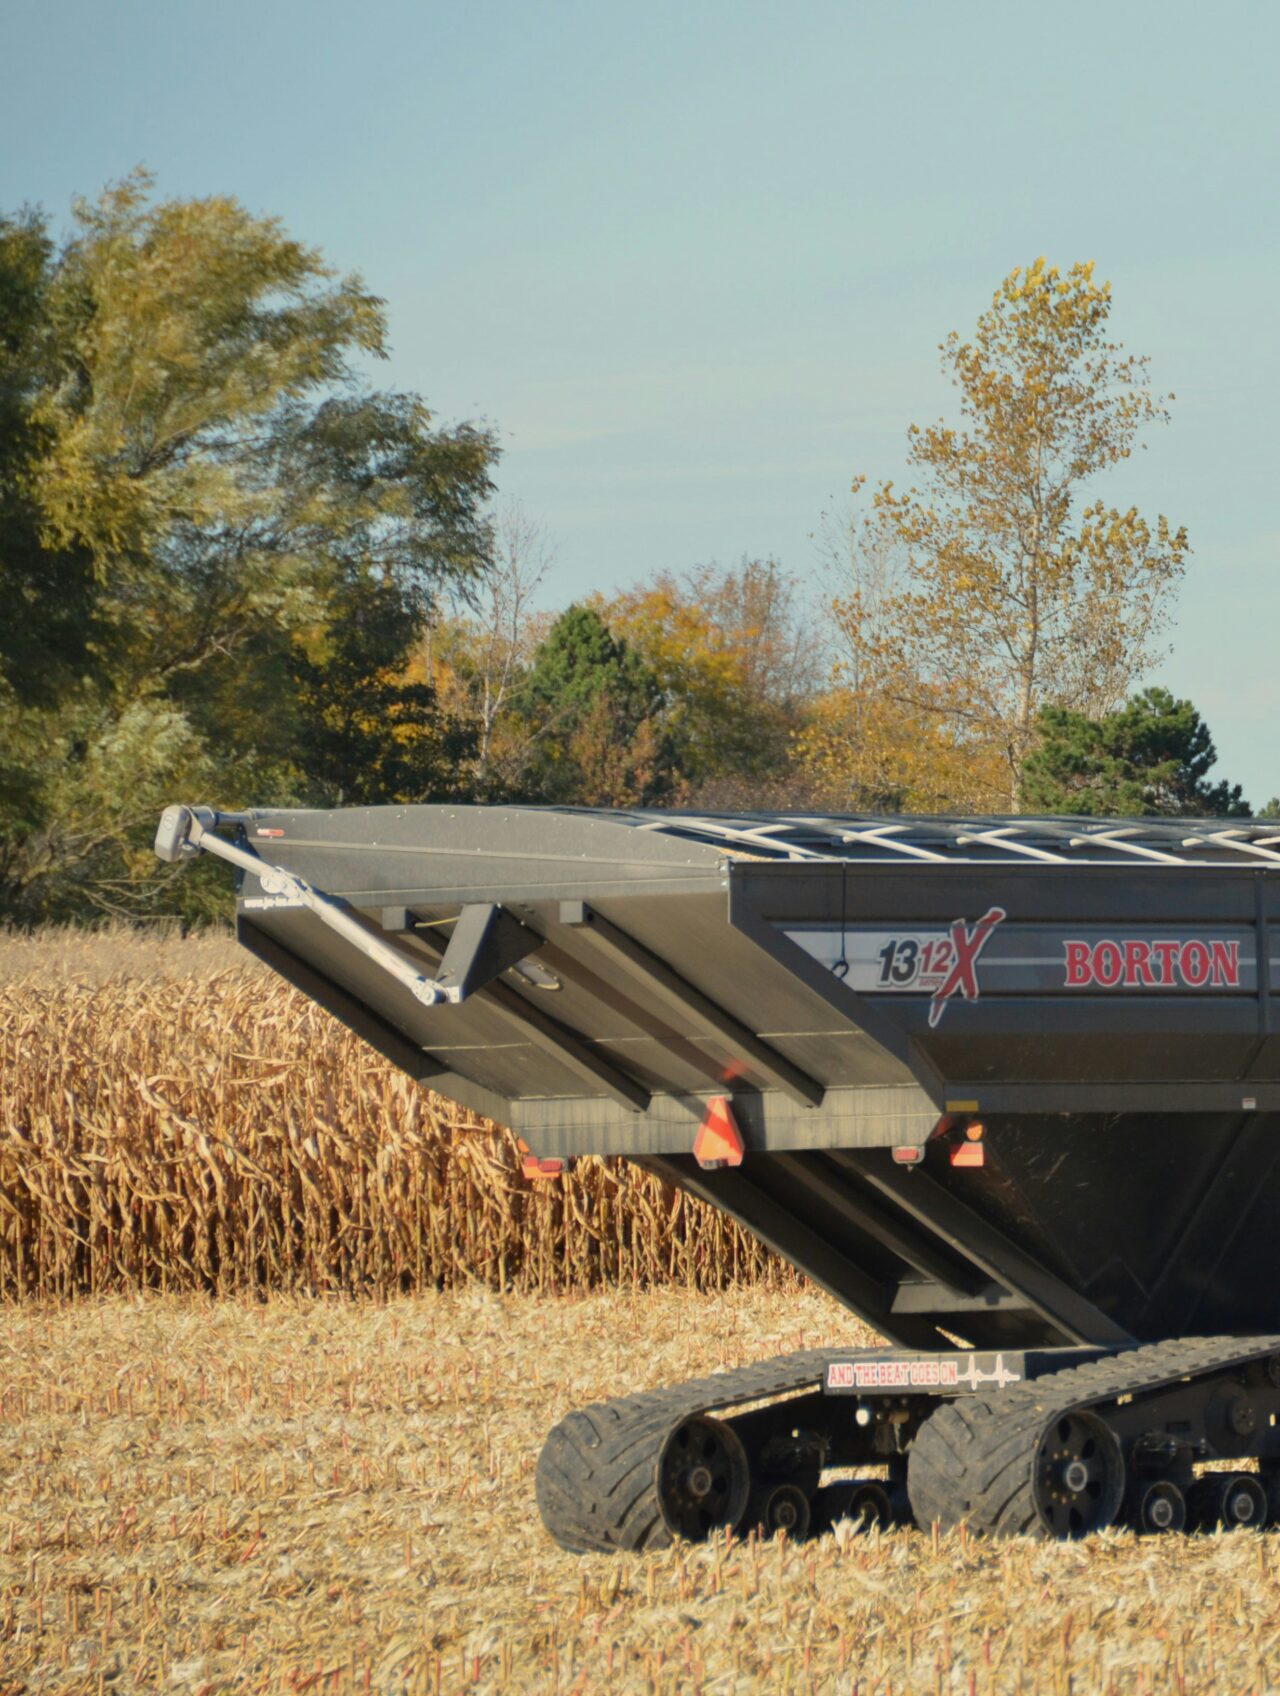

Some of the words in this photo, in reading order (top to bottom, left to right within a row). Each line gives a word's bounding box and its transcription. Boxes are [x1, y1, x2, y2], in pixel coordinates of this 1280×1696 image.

[1064, 940, 1240, 987] BORTON
[828, 1363, 854, 1387] AND
[854, 1363, 878, 1386] THE
[878, 1362, 909, 1386] BEAT
[910, 1362, 940, 1385] GOES
[941, 1361, 959, 1385] ON
